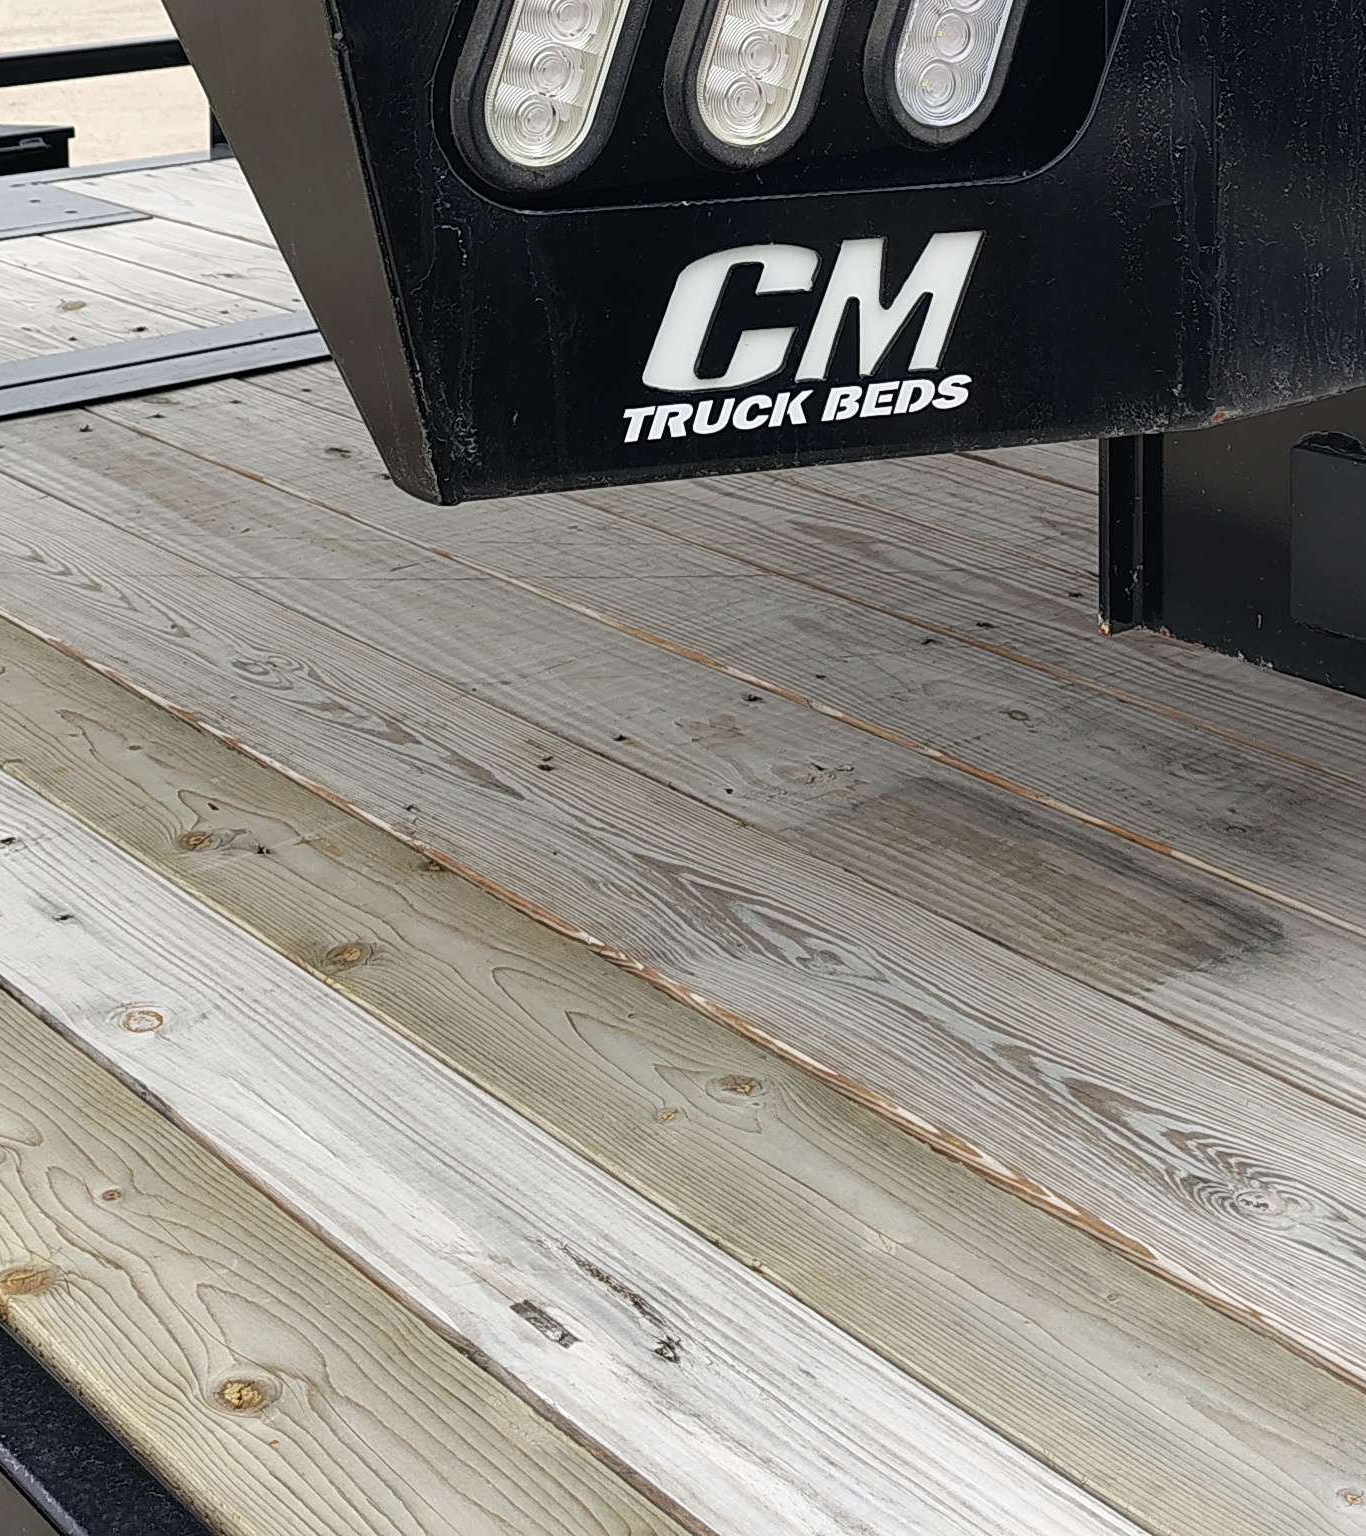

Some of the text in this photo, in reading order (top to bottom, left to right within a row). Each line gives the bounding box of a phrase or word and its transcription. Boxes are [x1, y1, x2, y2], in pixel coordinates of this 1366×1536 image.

[641, 230, 985, 391] CM
[622, 374, 972, 443] TRUCK BEDS
